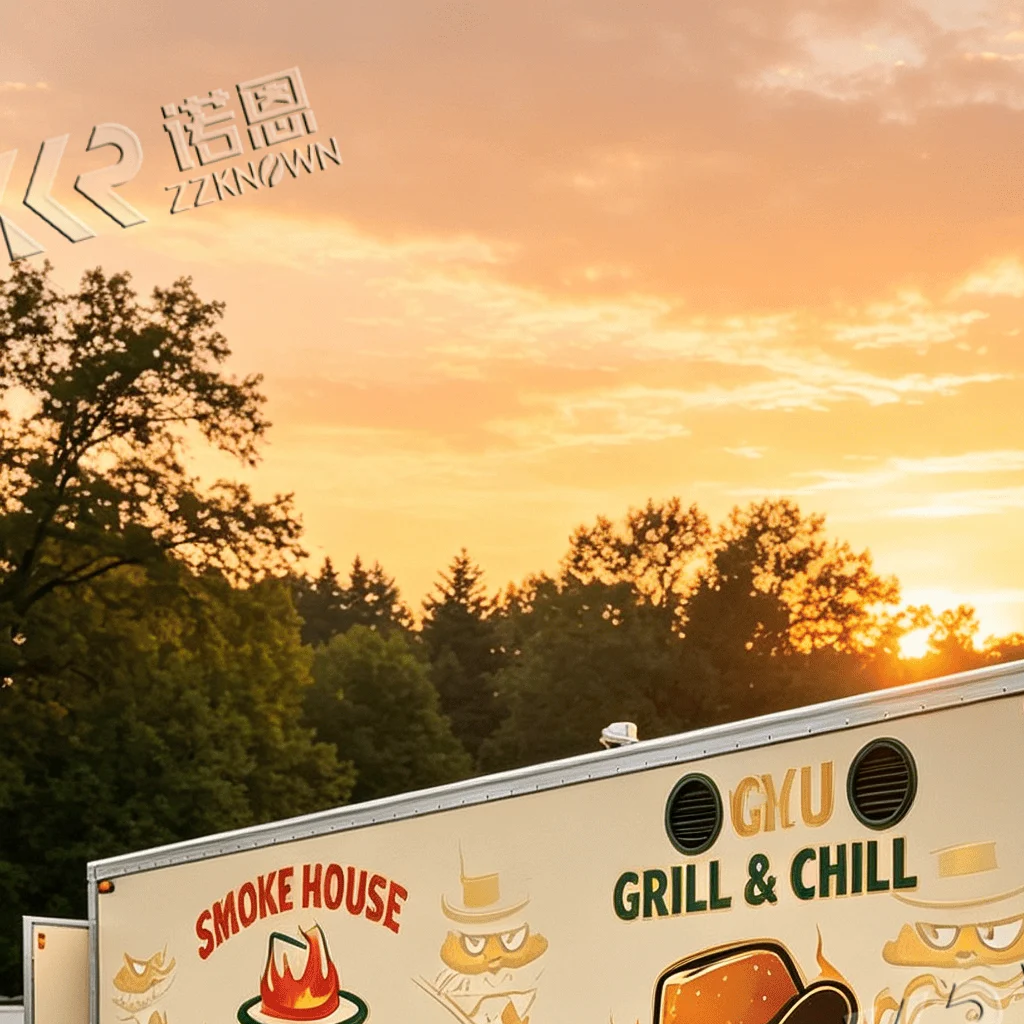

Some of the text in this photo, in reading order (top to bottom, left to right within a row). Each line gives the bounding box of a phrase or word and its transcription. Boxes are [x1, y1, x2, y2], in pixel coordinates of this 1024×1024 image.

[195, 863, 409, 960] SMOKE HOUSE
[613, 837, 918, 921] GRILL & CHILL
